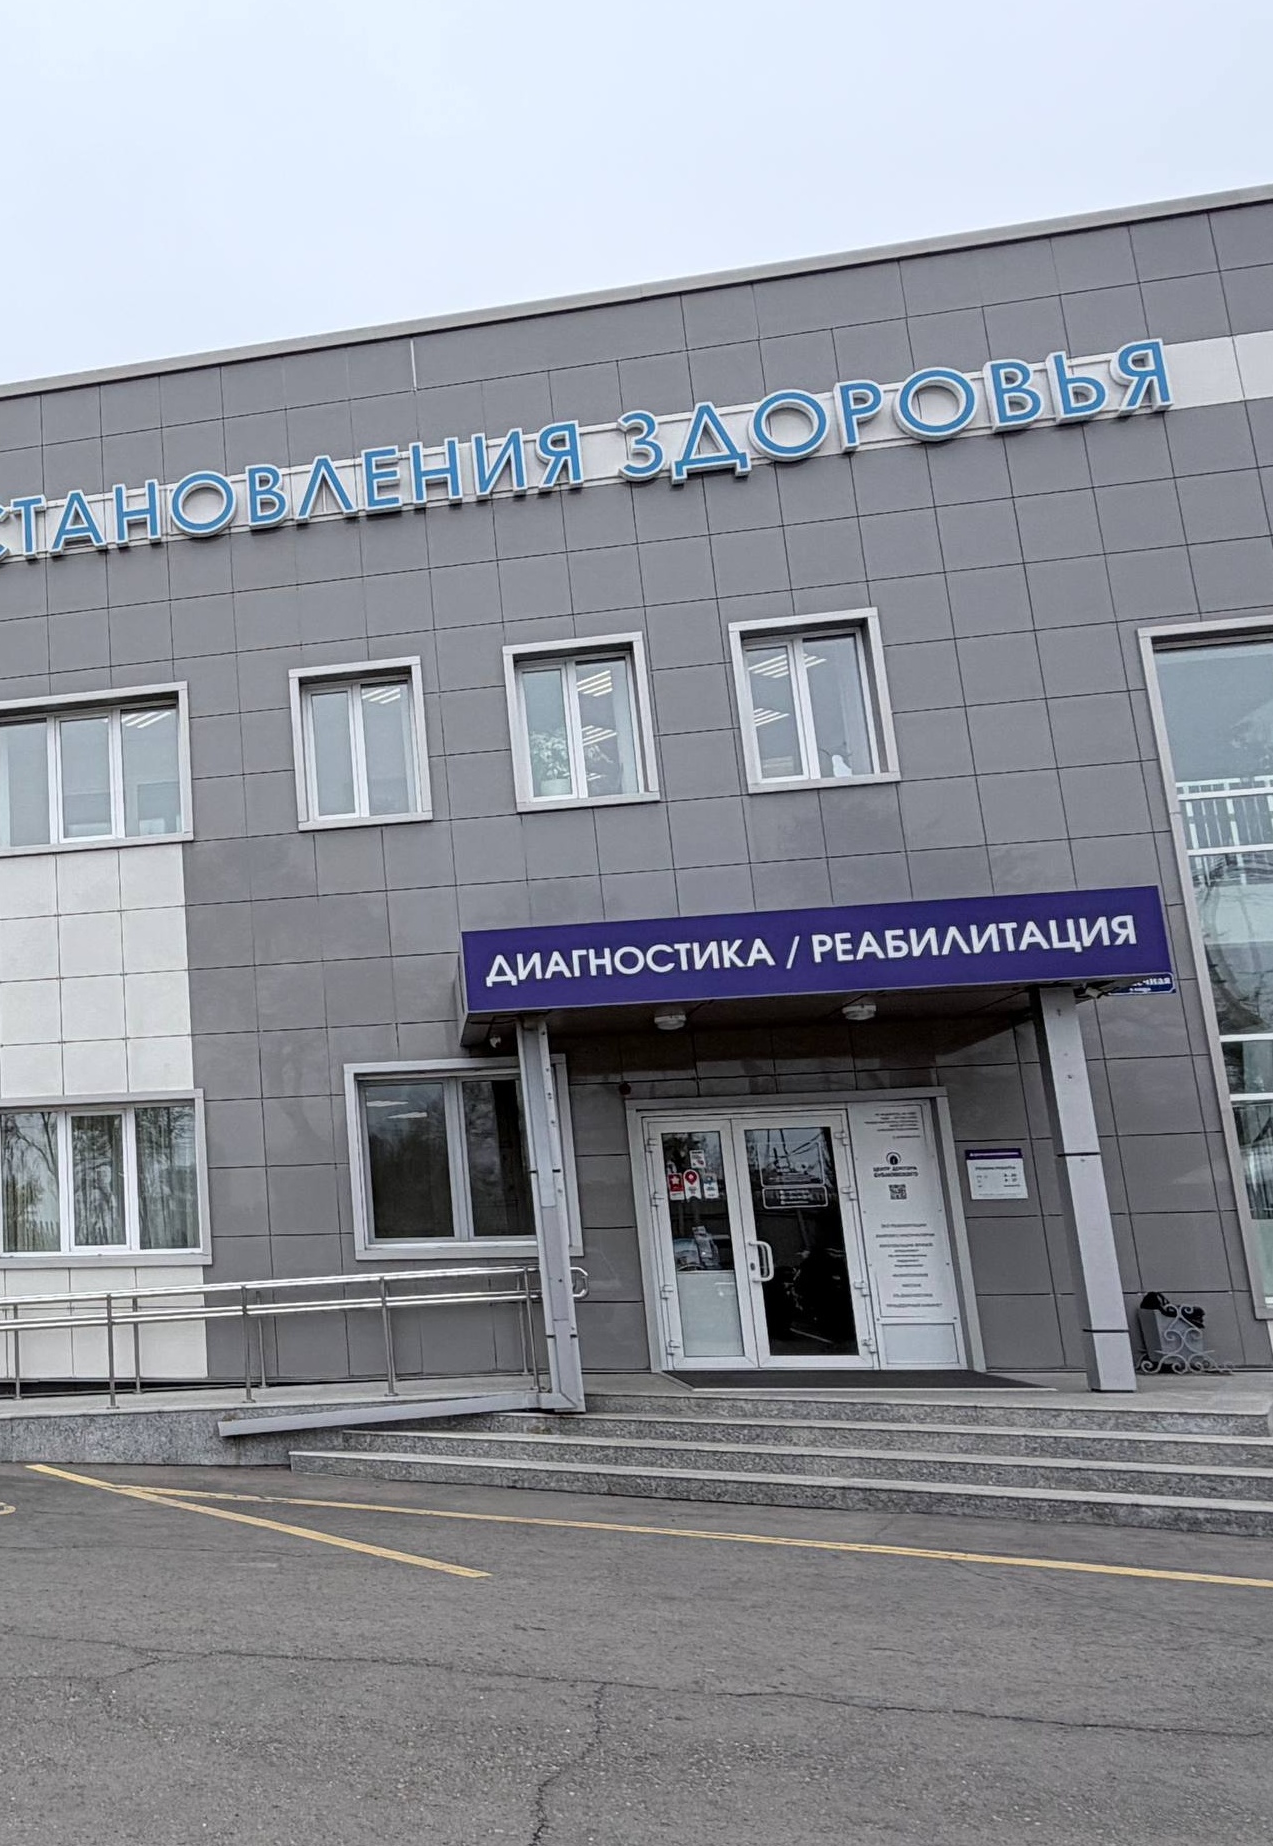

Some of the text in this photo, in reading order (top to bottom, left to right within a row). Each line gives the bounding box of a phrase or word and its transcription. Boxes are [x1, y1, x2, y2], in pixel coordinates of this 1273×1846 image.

[620, 341, 1172, 480] ЗДОРОВЬЯ
[485, 938, 776, 987] ДИАГНОСТИКА
[811, 915, 1137, 963] РЕАБИЛИТАЦИЯ
